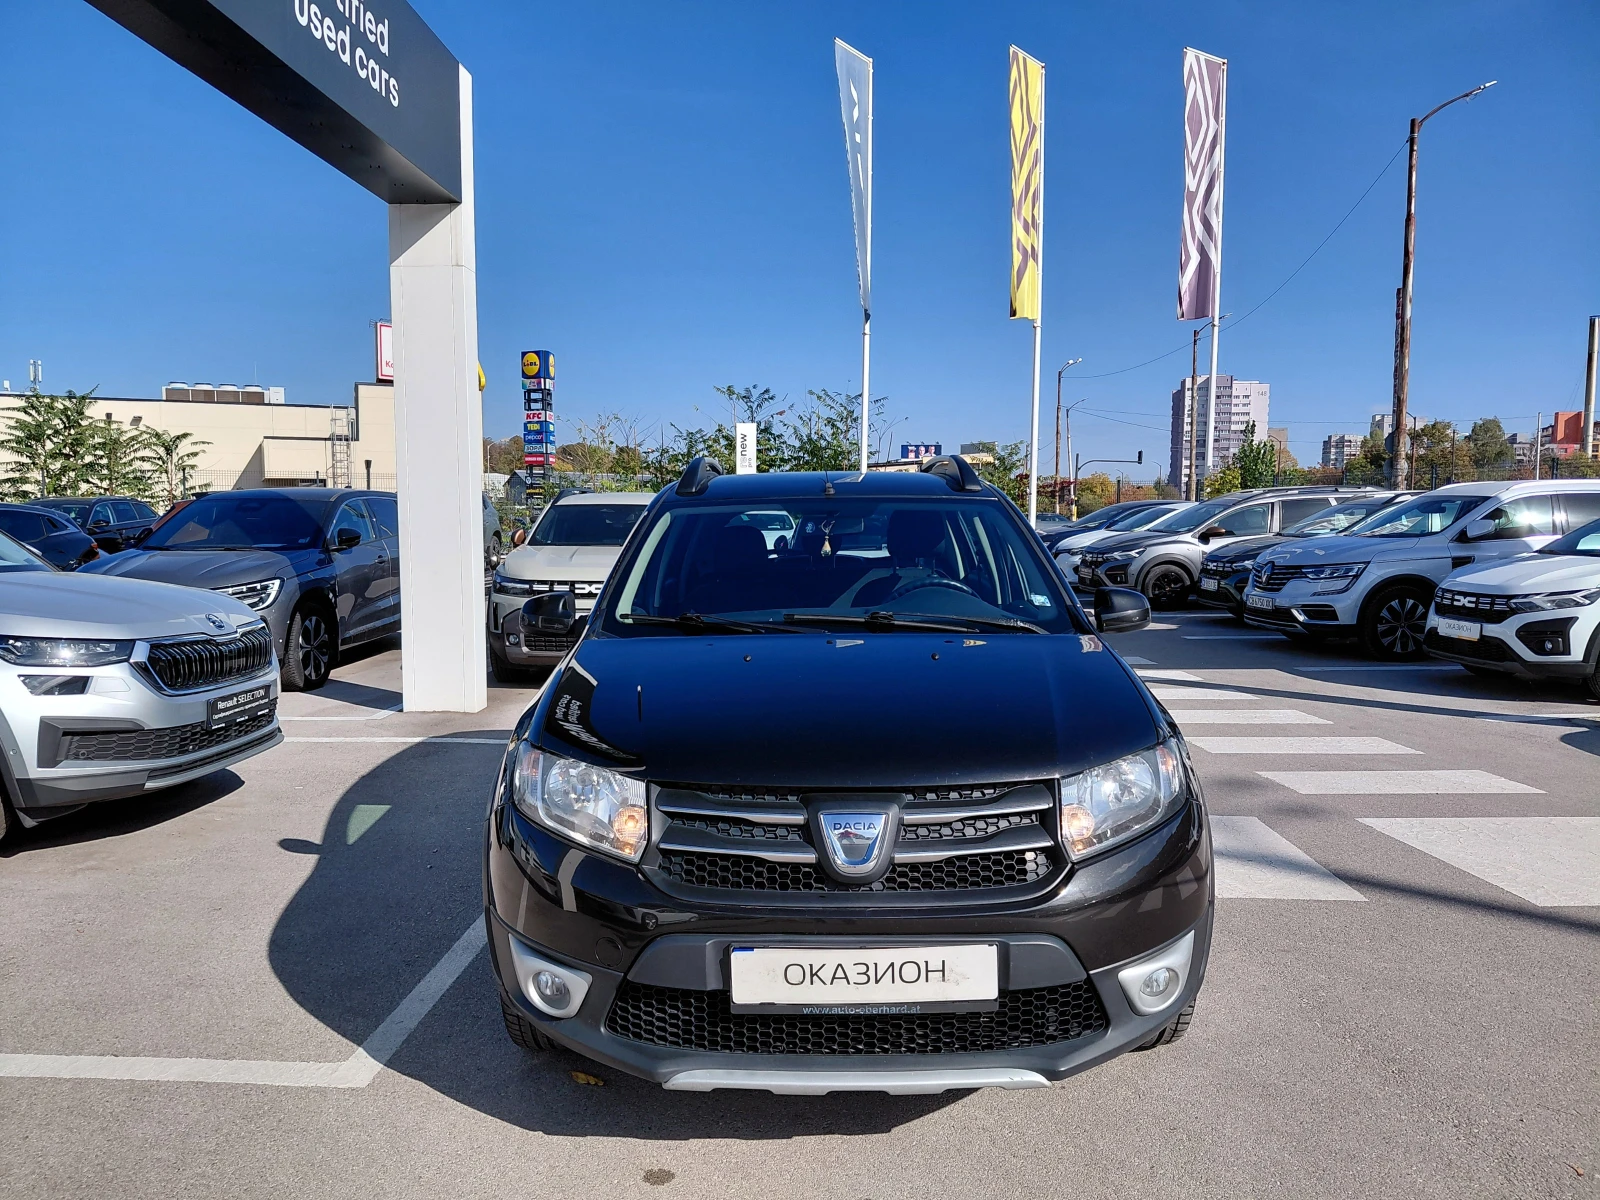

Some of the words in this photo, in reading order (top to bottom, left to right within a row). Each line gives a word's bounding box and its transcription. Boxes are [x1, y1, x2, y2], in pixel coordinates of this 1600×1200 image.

[294, 0, 351, 67] Used
[355, 47, 399, 108] cars
[525, 412, 542, 420] KFC
[217, 697, 237, 710] Renault
[238, 688, 266, 704] SELECTION
[833, 822, 877, 831] DACIA
[783, 959, 946, 986] ОКАЗИОН
